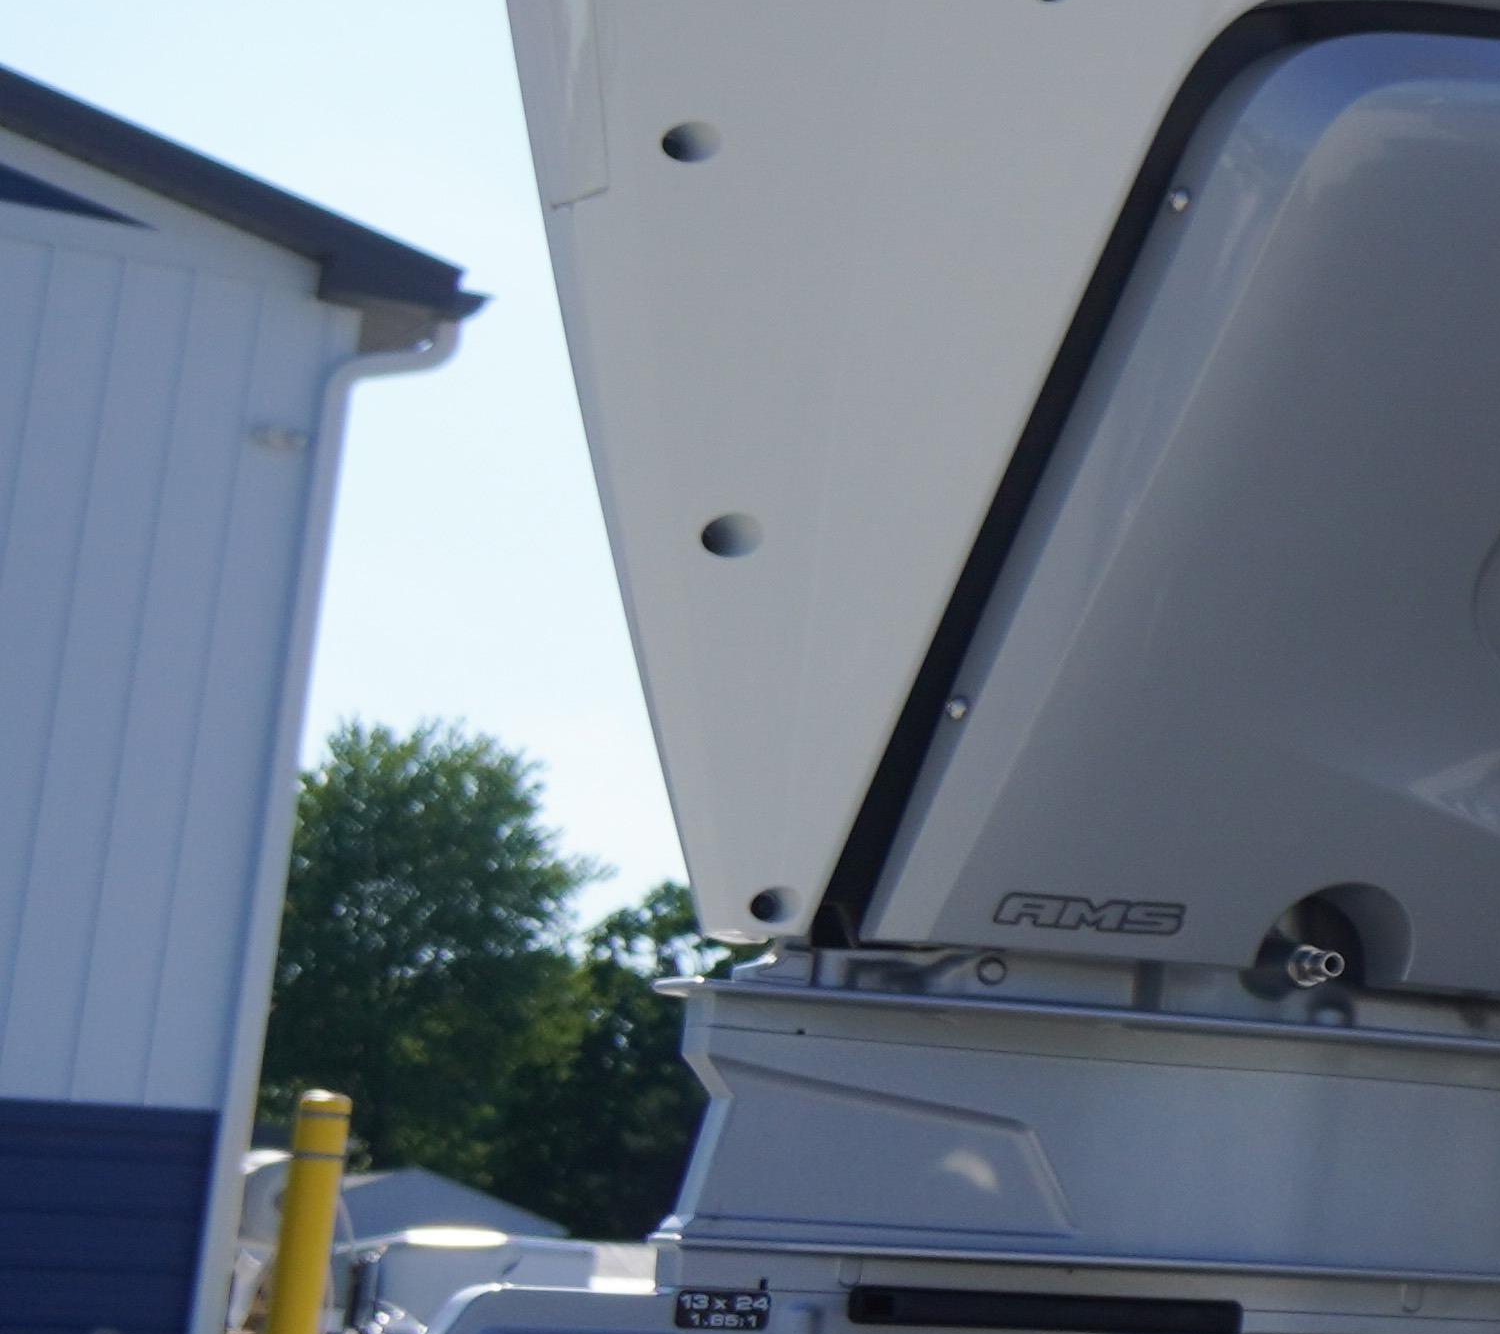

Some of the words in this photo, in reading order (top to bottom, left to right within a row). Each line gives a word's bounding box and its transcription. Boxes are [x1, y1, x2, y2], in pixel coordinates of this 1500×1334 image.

[993, 891, 1187, 936] AMS
[680, 1293, 709, 1309] 13
[735, 1295, 769, 1311] 24
